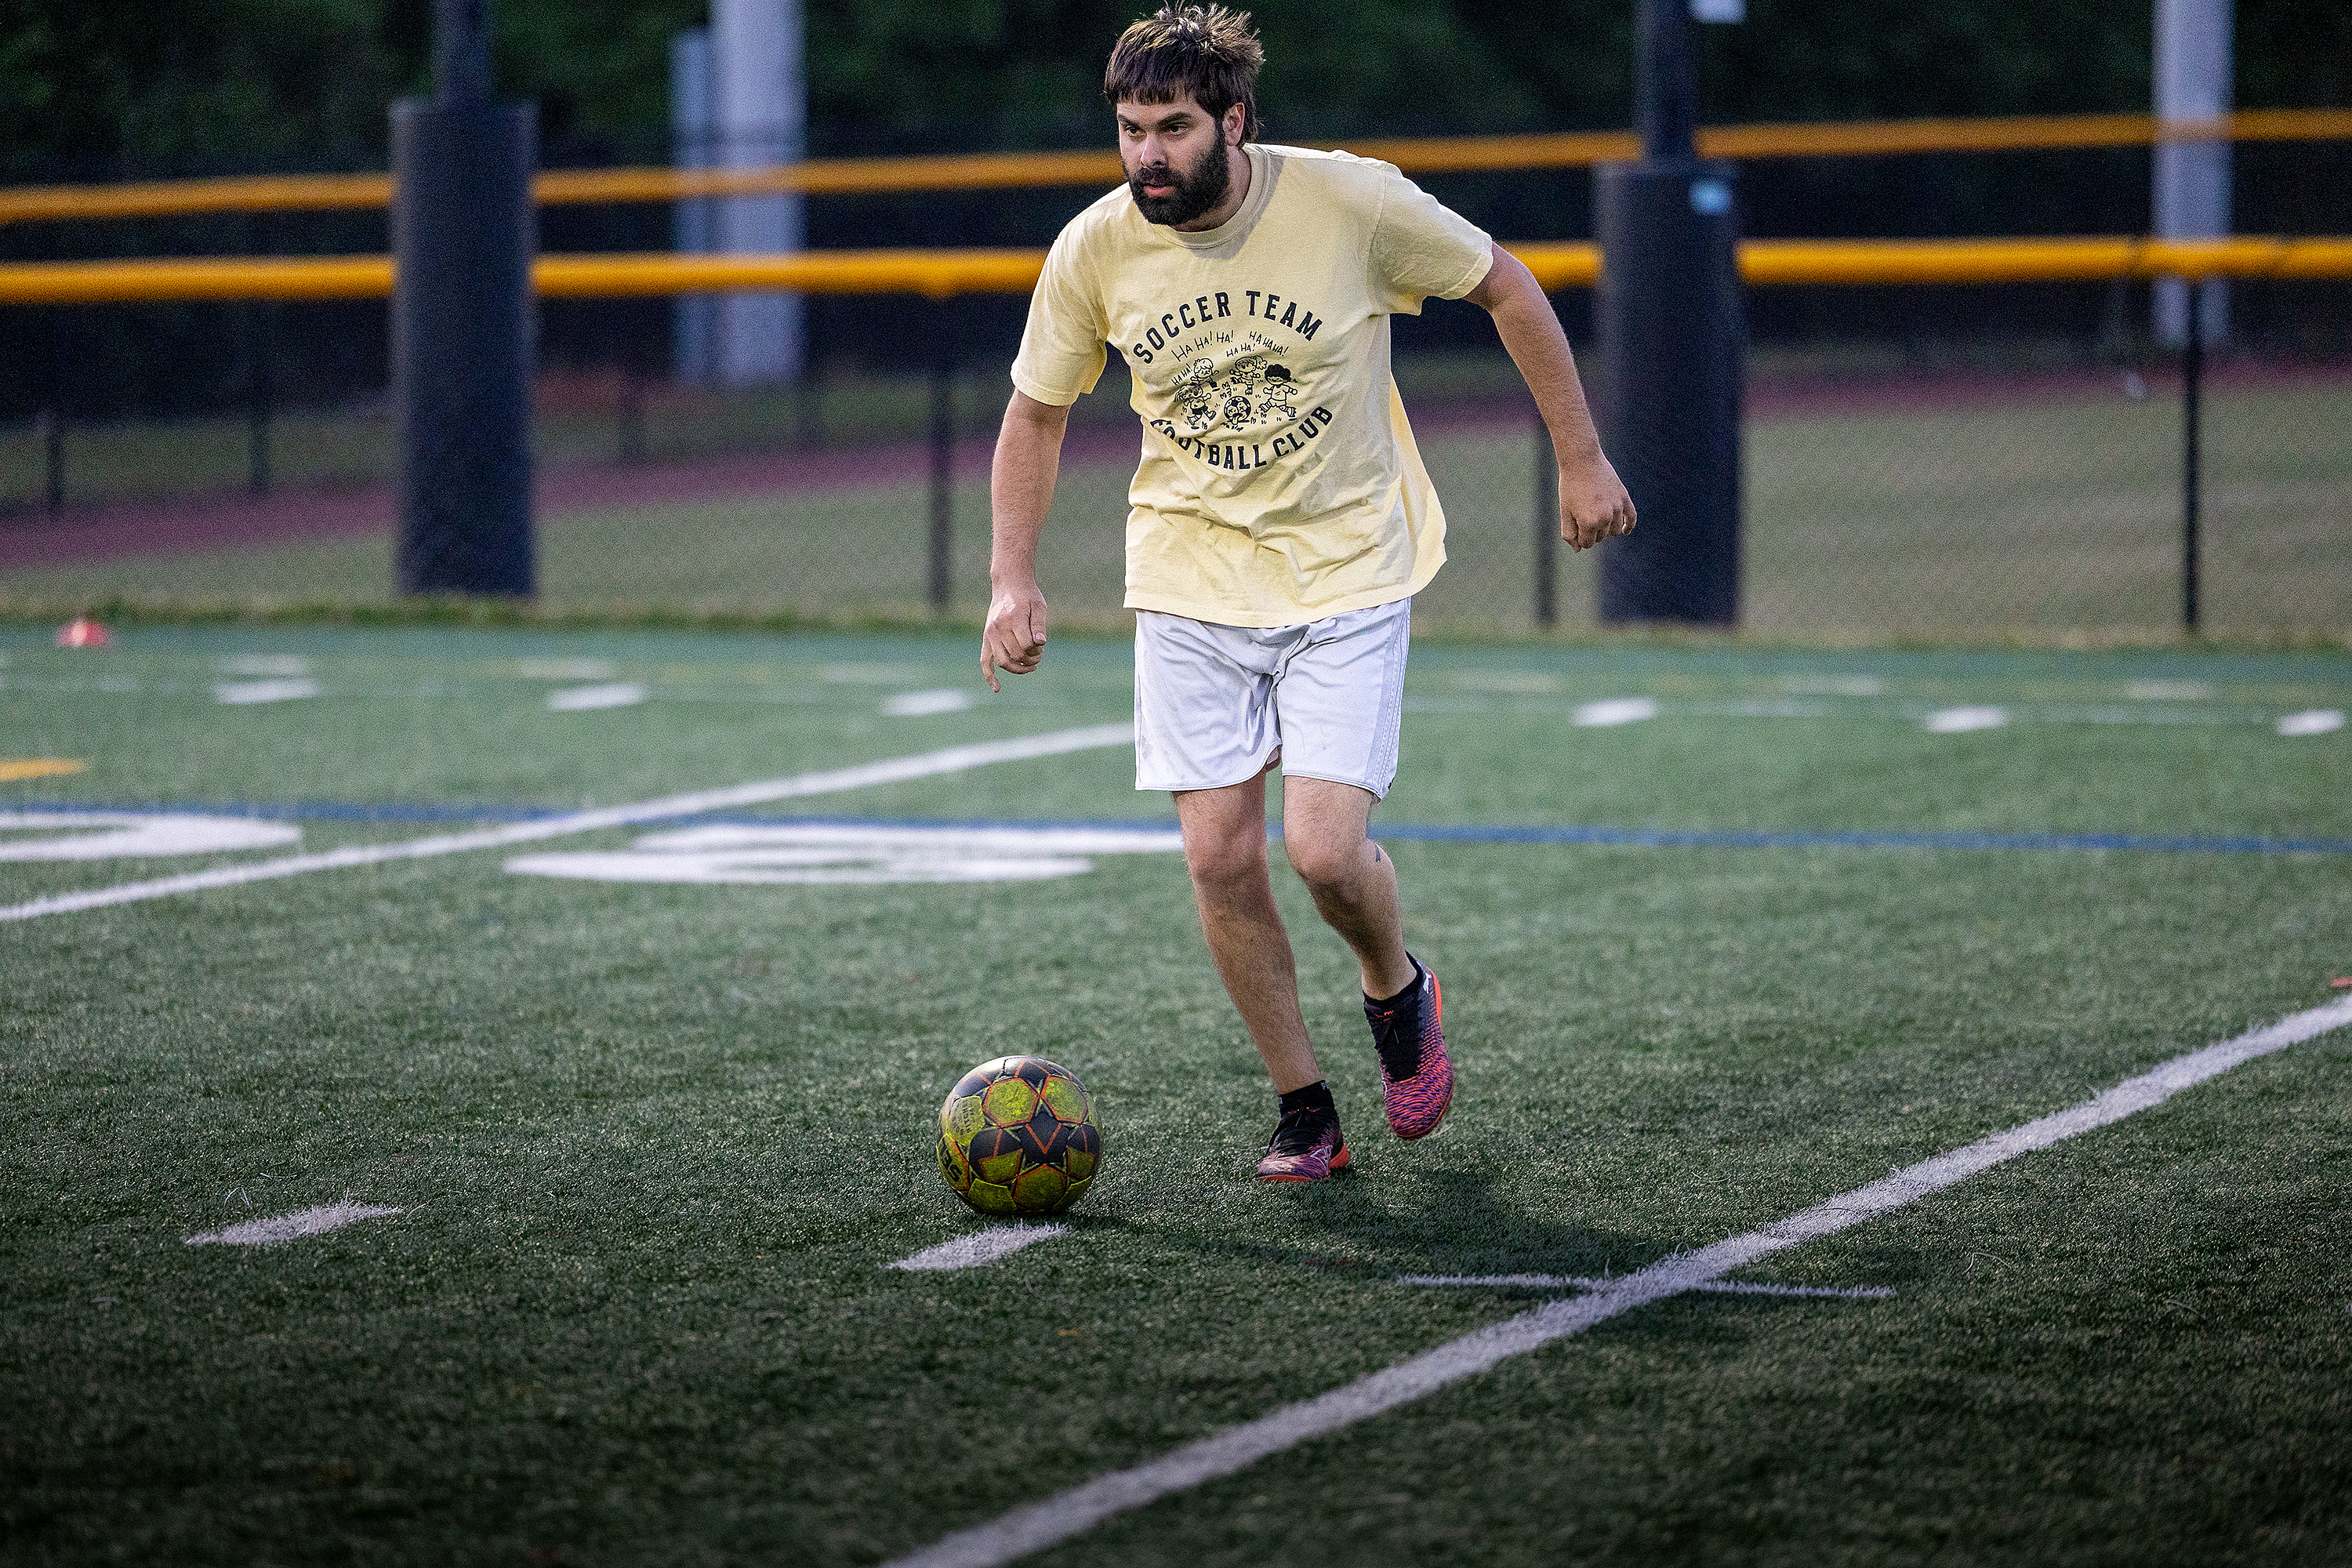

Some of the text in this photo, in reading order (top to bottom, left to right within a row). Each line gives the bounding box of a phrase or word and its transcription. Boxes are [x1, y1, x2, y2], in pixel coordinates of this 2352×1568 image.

[1133, 290, 1323, 365] SOCCER TEAM
[1216, 329, 1234, 343] HA!
[1272, 405, 1333, 457] CLUB
